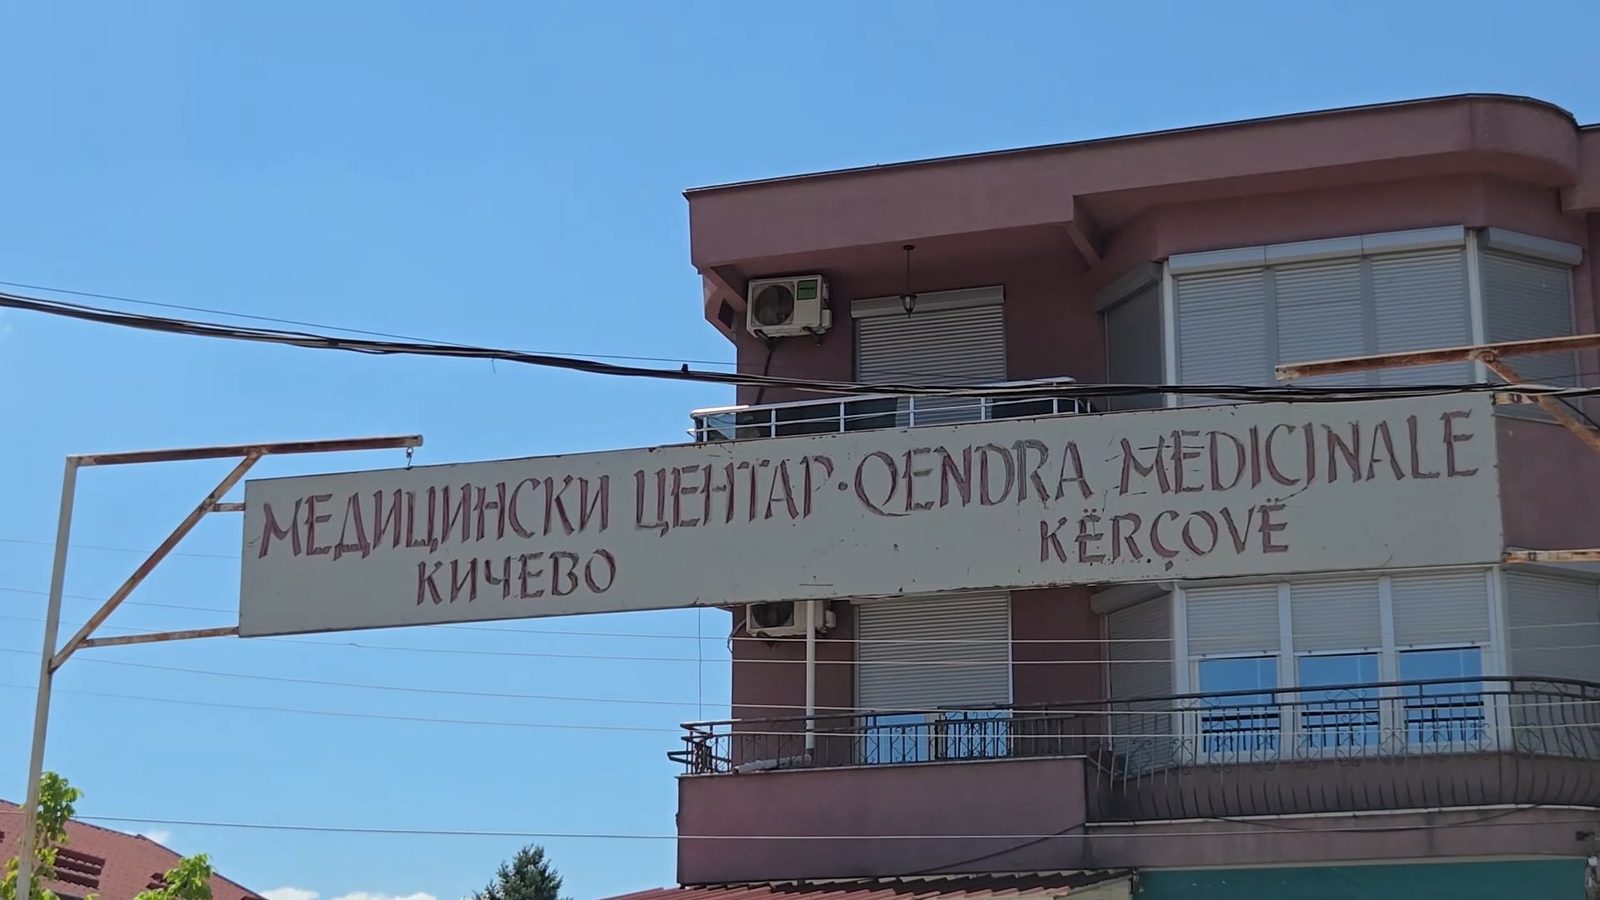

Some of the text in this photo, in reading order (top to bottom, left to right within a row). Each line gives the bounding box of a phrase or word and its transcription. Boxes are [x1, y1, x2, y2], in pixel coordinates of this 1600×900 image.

[259, 455, 834, 560] МЕДИЦИНСКИ ЦЕНТАР
[854, 411, 1479, 517] QENDRA MEDICINALE
[416, 549, 616, 606] КИЧЕВО
